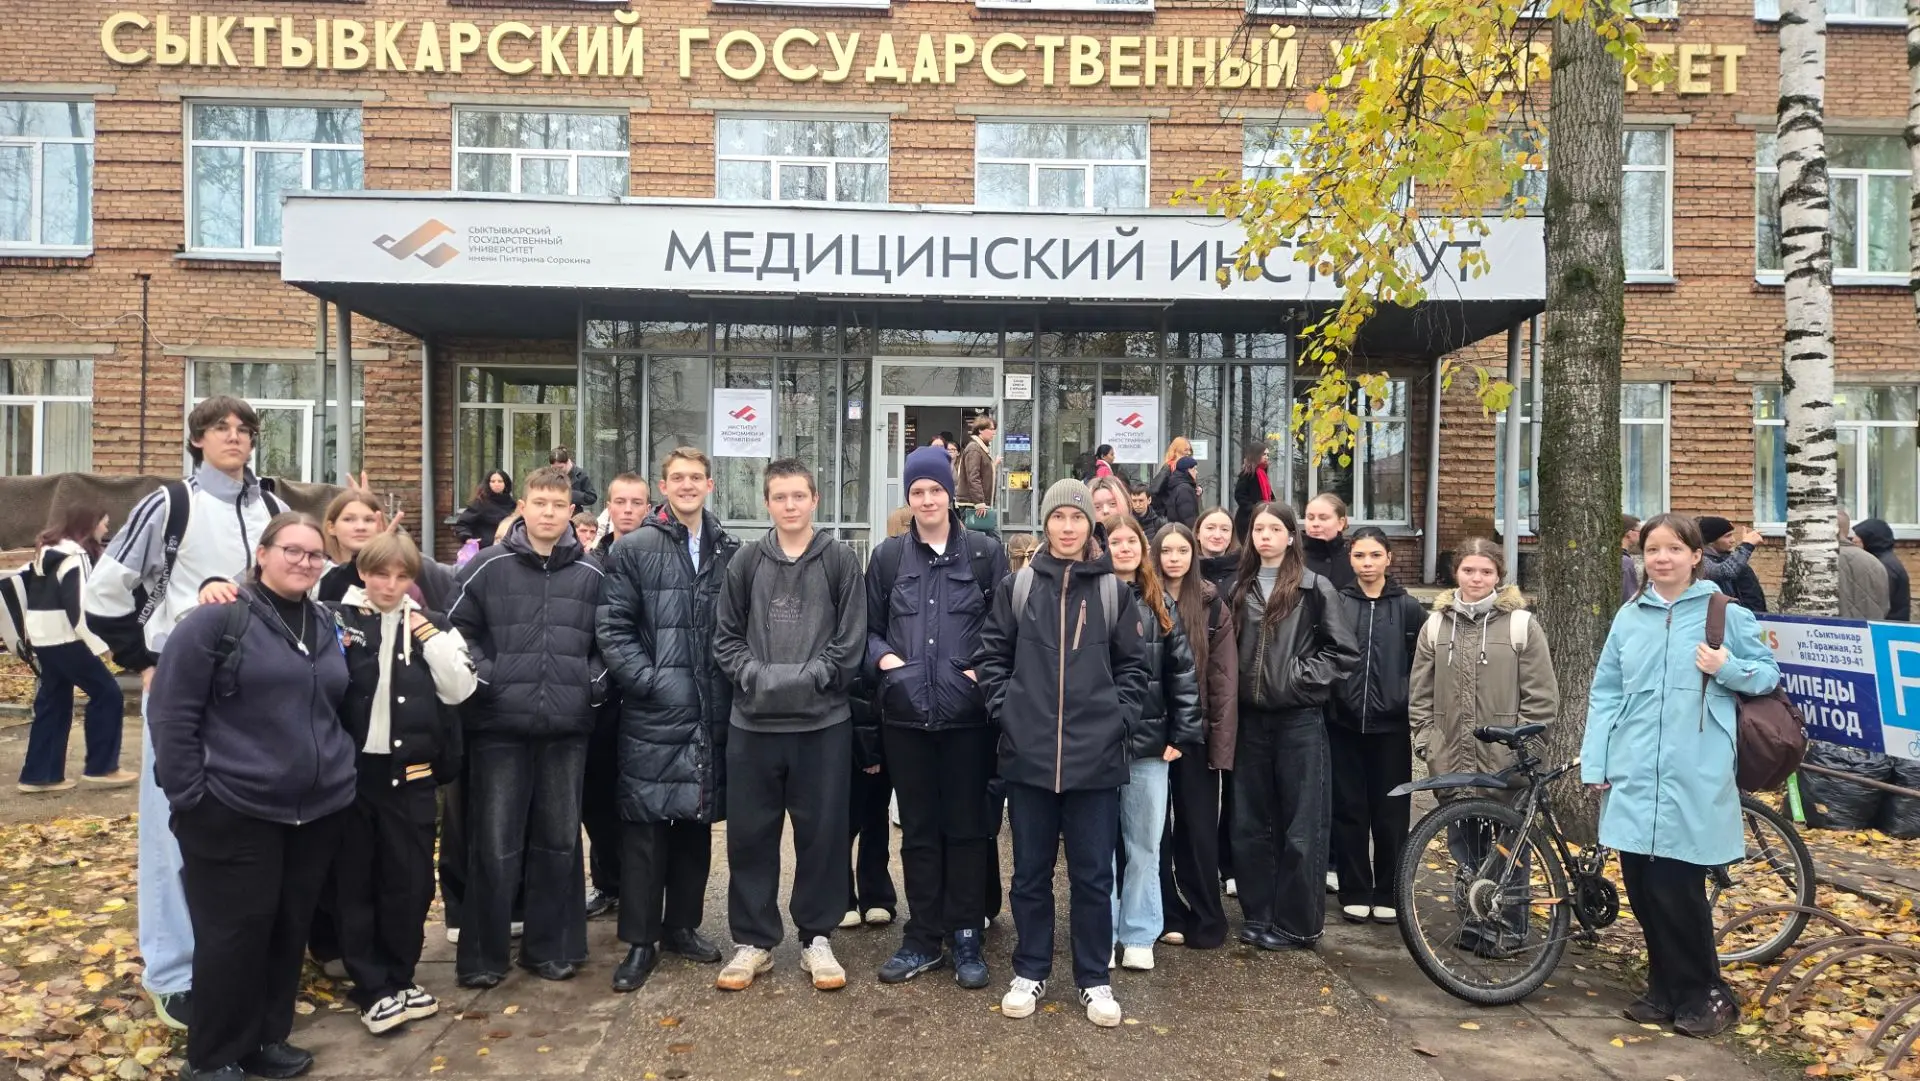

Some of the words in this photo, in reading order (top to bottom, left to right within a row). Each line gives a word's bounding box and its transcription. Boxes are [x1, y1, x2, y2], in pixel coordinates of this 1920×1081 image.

[100, 9, 645, 78] СЫКТЫВКАРСКИЙ
[678, 23, 1300, 90] ГОСУДАРСТВЕННЫЙ
[468, 226, 551, 235] СЫКТЫВКАРСКИЙ
[468, 235, 563, 245] ГОСУДАРСТВЕННЫЙ
[468, 245, 534, 254] УНИВЕРСИТЕТ
[499, 255, 545, 264] Питирима
[547, 256, 591, 265] Сорокина
[664, 226, 1145, 284] МЕДИЦИНСКИЙ
[1813, 629, 1861, 643] Сыктывкар
[1852, 644, 1863, 654] 25
[1820, 706, 1863, 739] ГОД
